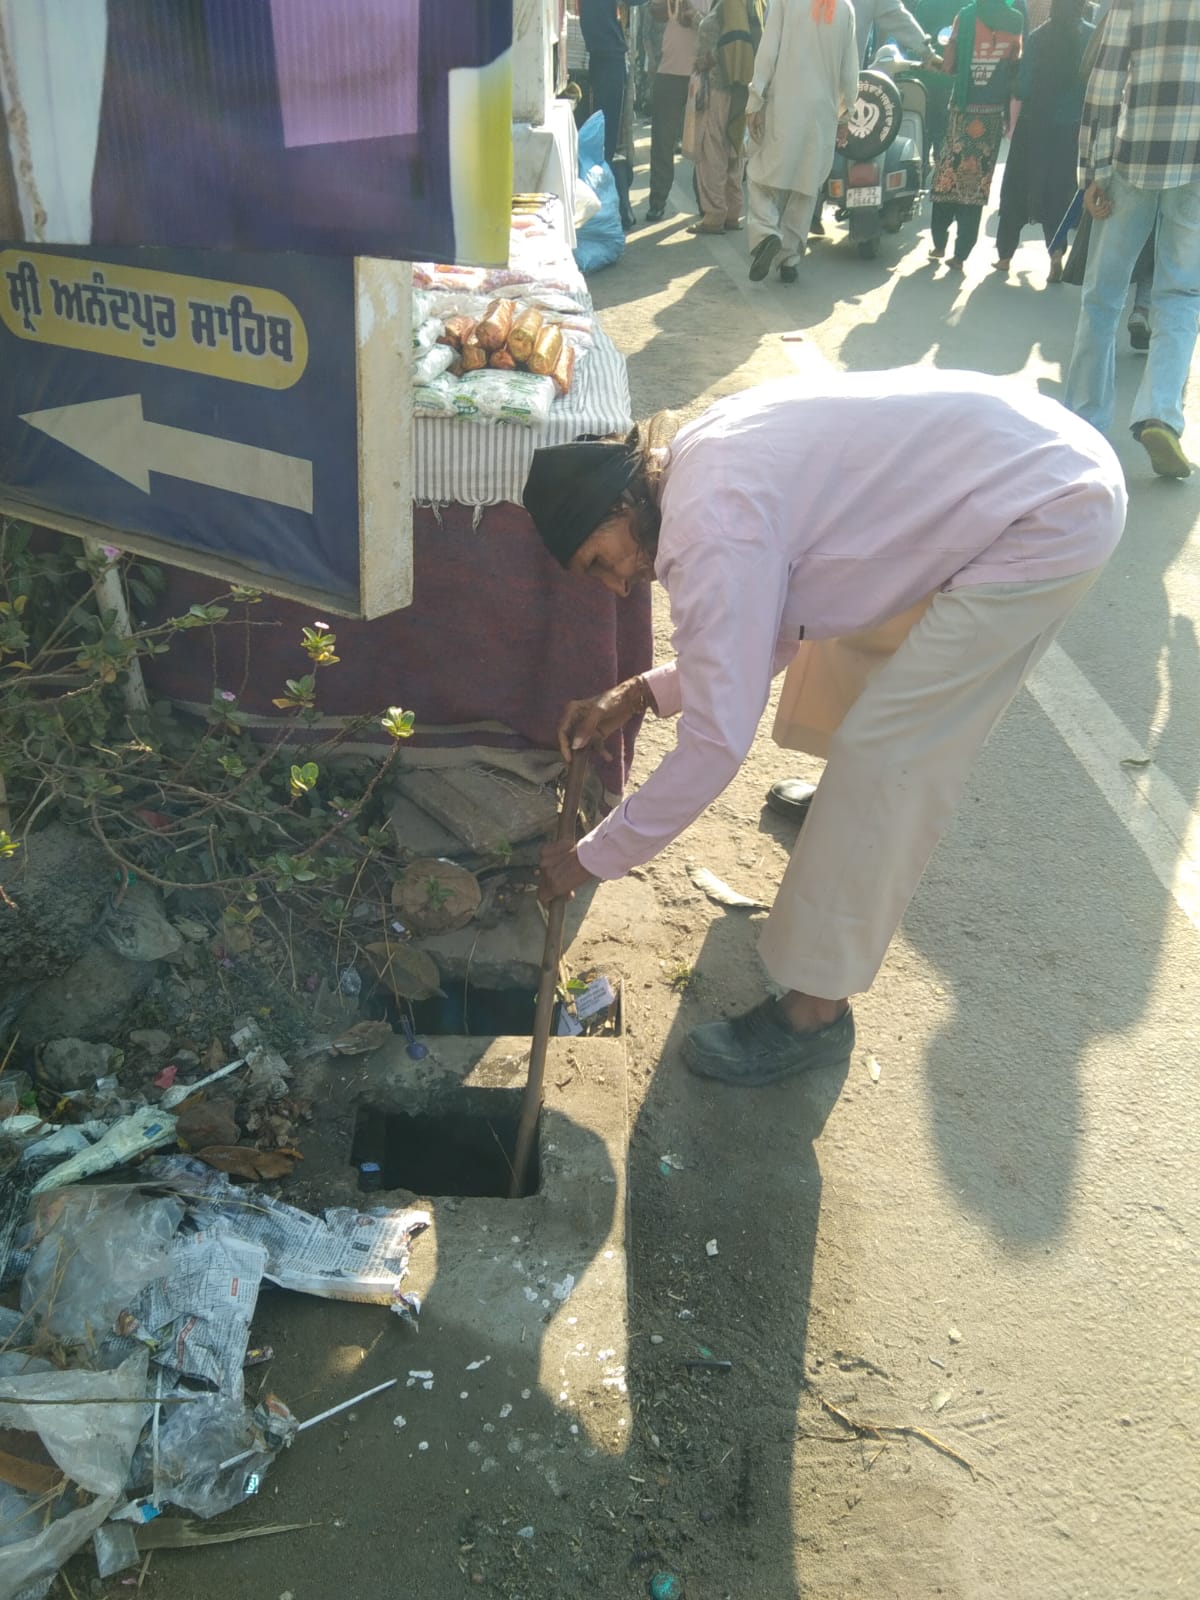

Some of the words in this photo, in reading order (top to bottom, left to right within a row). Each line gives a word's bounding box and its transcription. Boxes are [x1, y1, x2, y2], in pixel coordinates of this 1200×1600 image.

[6, 261, 42, 332] ਸ੍ਰੀ
[50, 271, 176, 347] ਅਨੰਦਪੁਰ
[188, 294, 293, 363] ਸਾਹਿਬ
